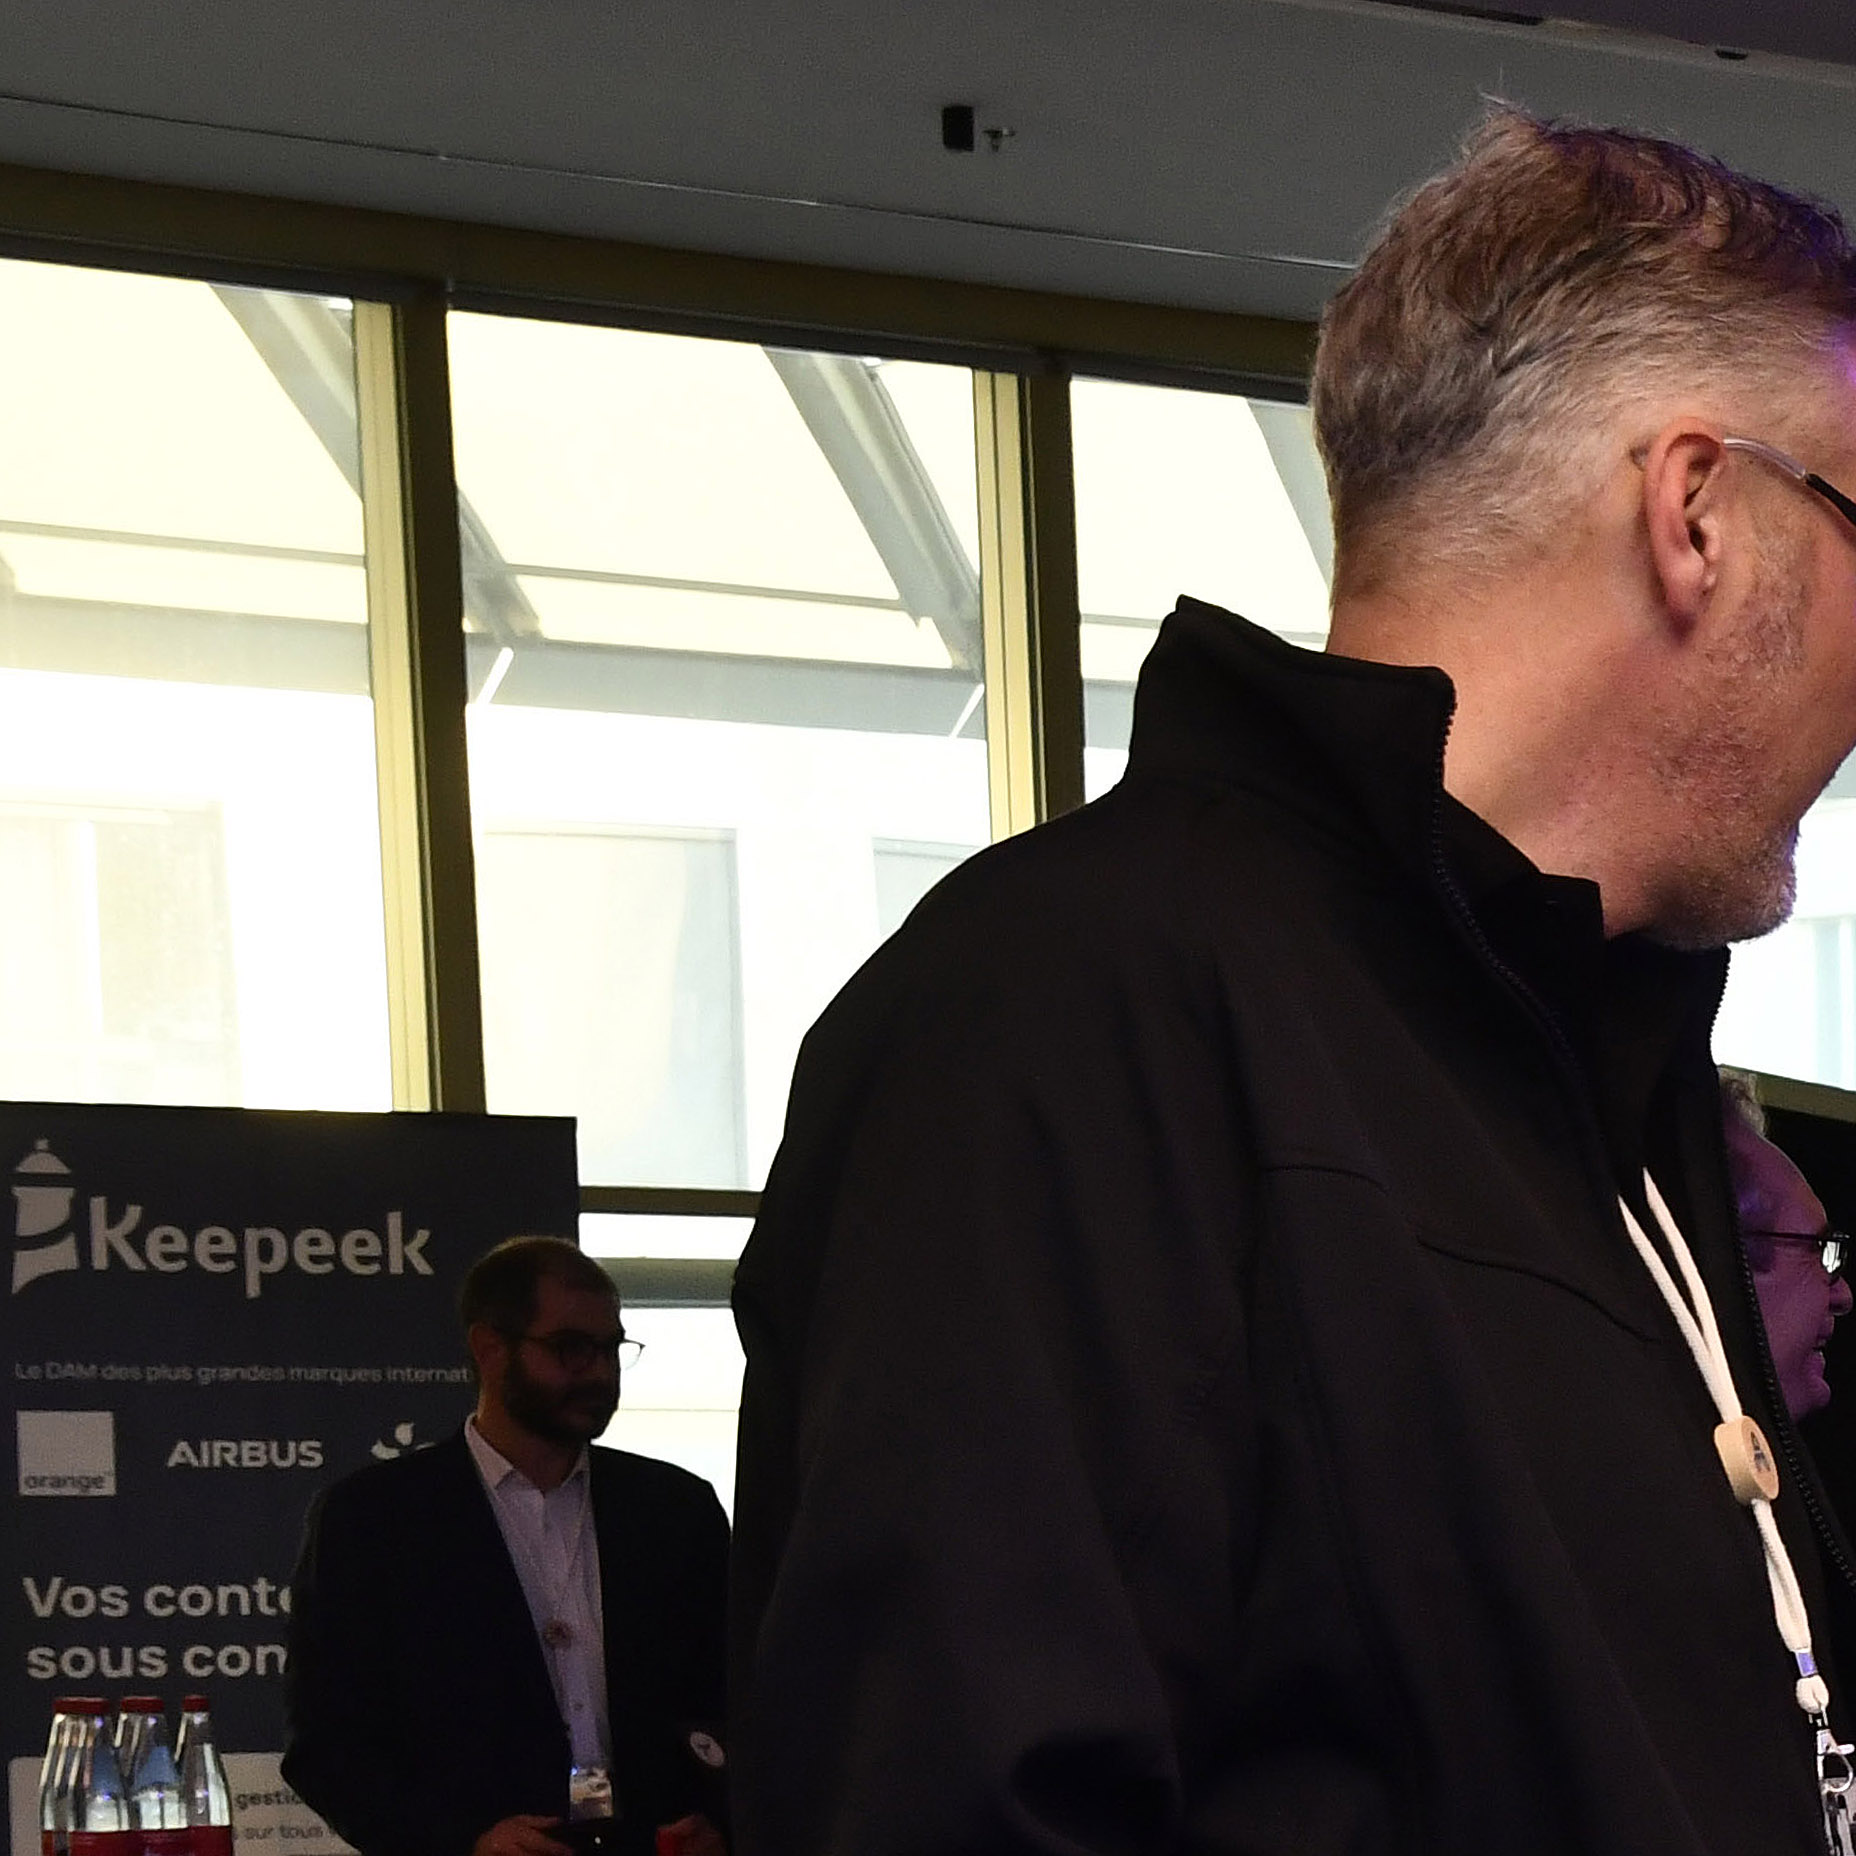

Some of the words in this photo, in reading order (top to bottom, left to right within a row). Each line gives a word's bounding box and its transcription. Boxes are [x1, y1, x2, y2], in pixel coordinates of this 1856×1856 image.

[88, 1195, 435, 1300] Keepeek
[199, 1363, 287, 1387] grandes
[290, 1364, 383, 1388] marques
[386, 1363, 473, 1384] internat
[166, 1440, 325, 1469] AIRBUS
[24, 1472, 107, 1491] orange
[22, 1576, 130, 1619] Vos
[26, 1643, 169, 1680] sous
[182, 1642, 288, 1679] con
